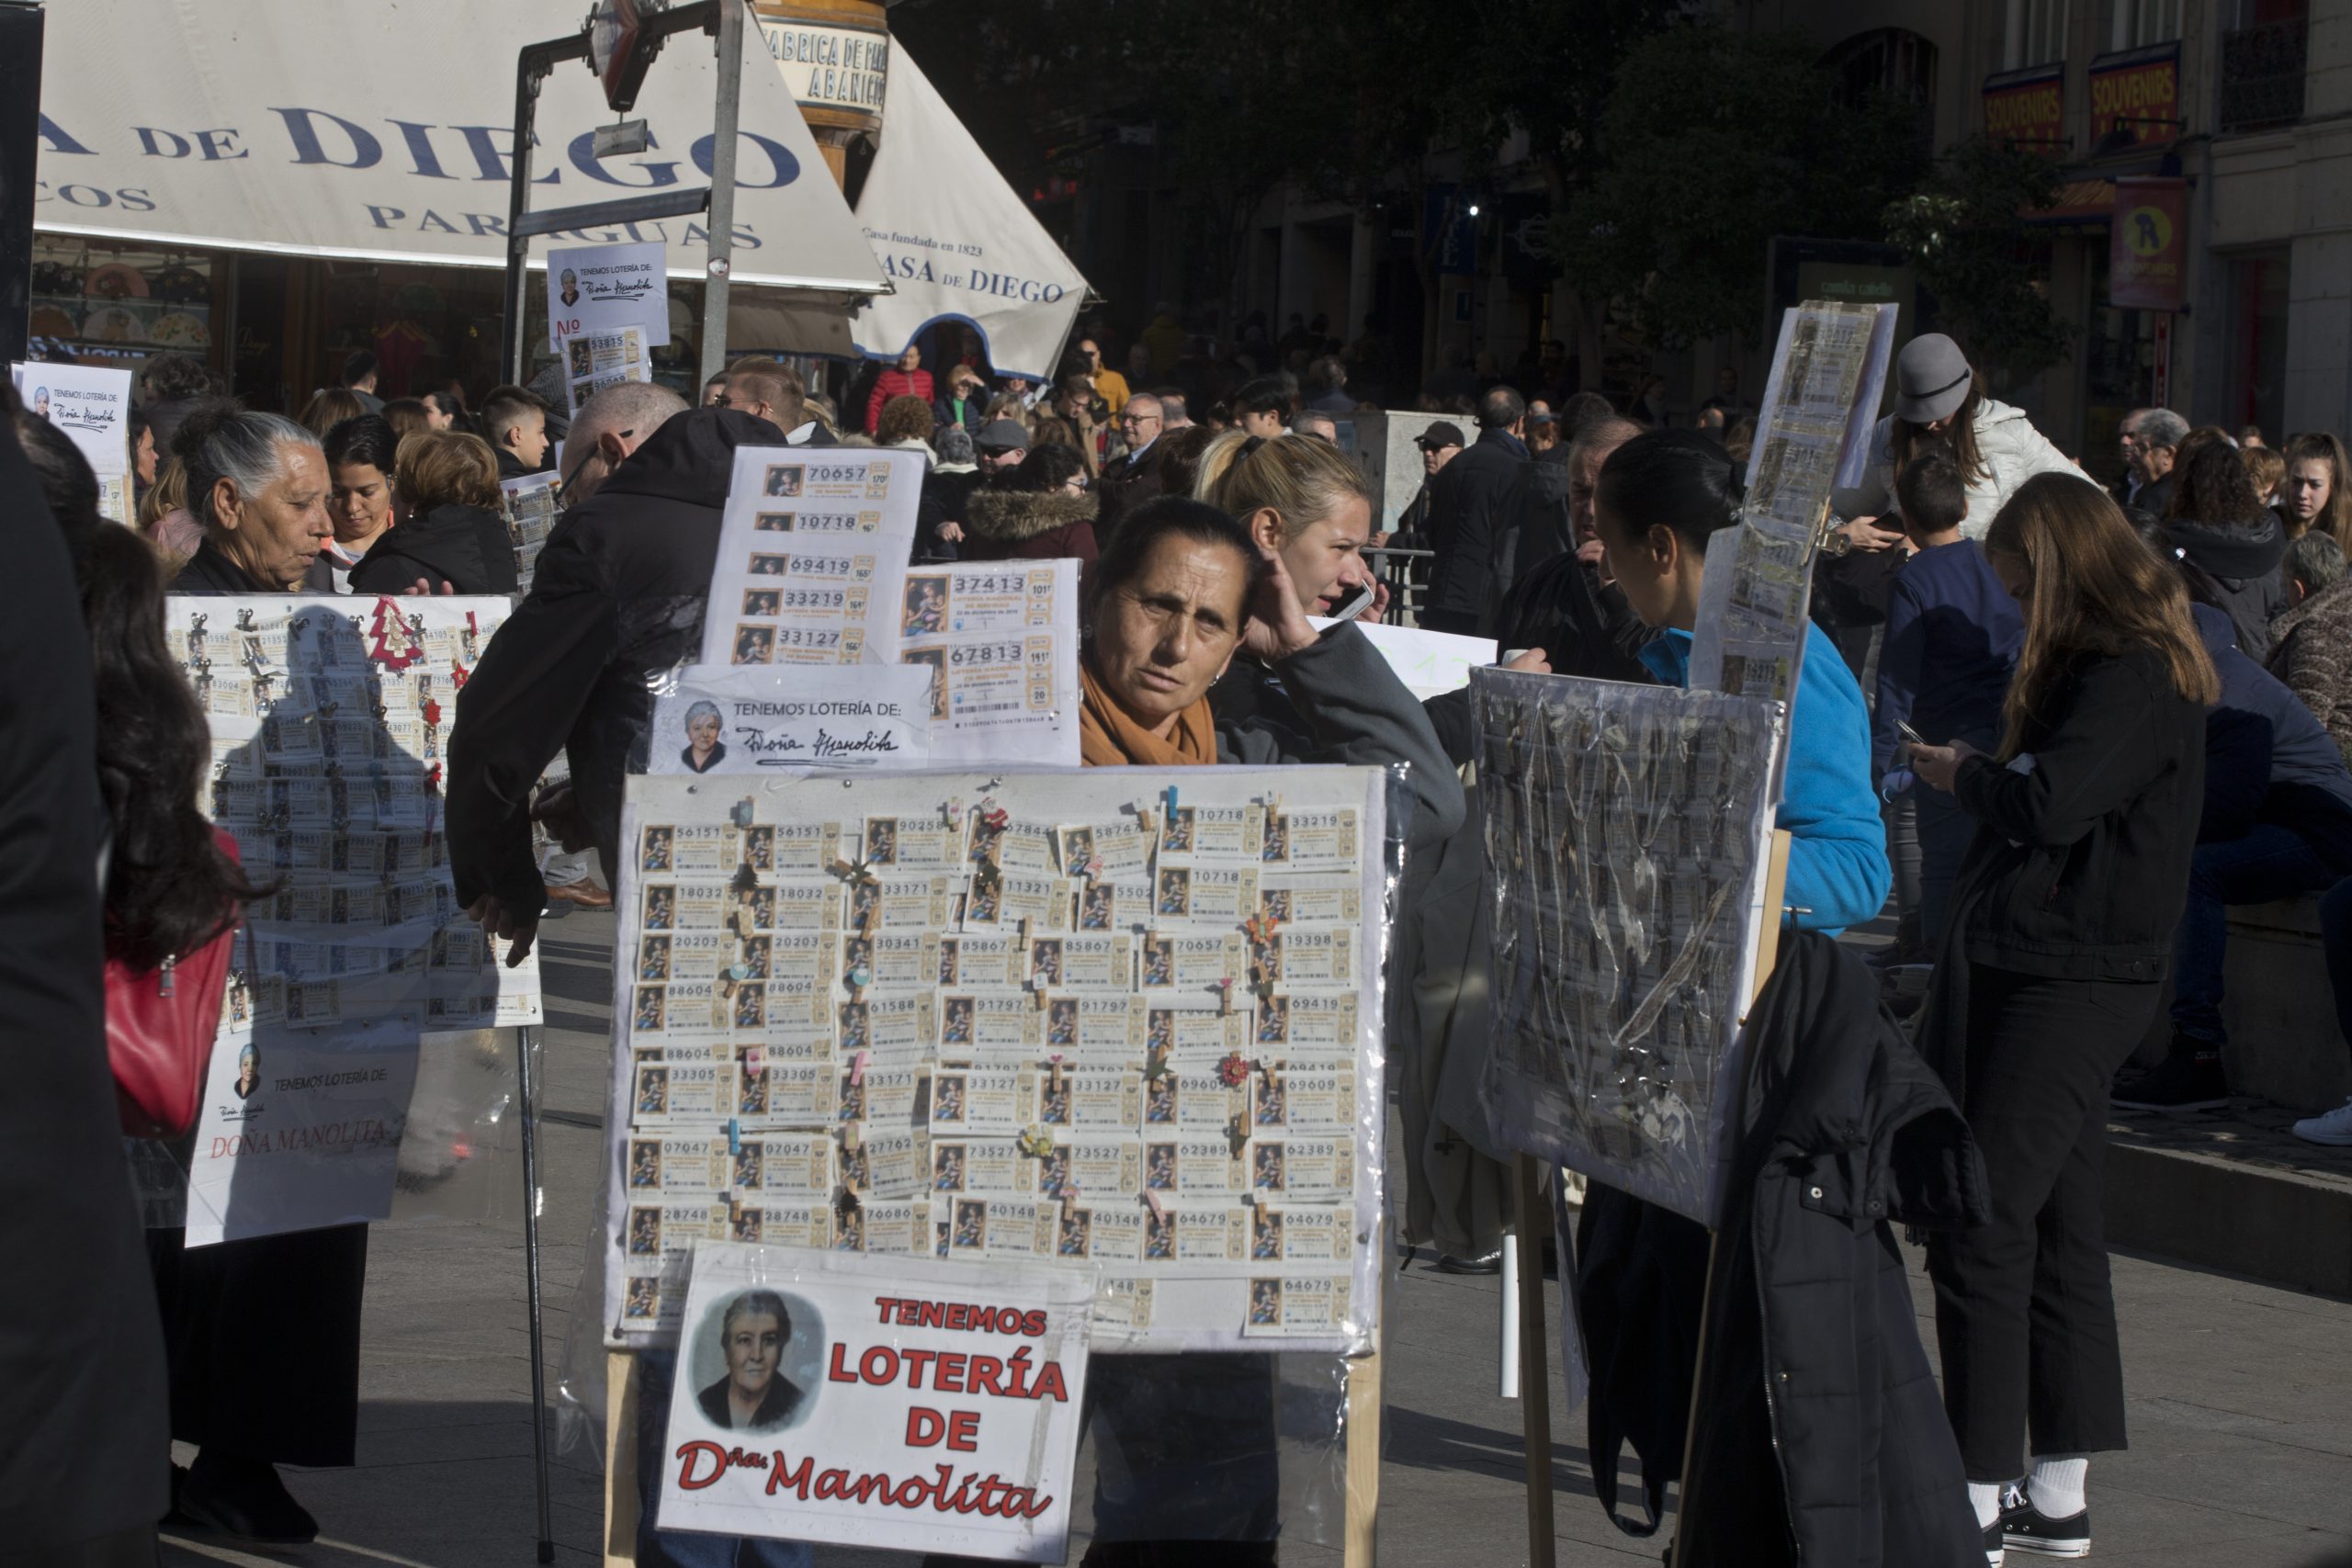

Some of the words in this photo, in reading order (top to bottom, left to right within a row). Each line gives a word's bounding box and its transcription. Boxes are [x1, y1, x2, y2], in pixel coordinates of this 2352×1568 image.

[764, 29, 839, 66] ABRICA
[844, 38, 864, 69] DE
[2092, 66, 2174, 115] SOUVENIRS
[1985, 88, 2059, 131] SOUVENIRS
[130, 127, 249, 161] DE
[267, 107, 801, 189] DIEGO
[861, 227, 888, 242] Casa
[891, 231, 939, 250] fundada
[941, 243, 954, 253] en
[957, 243, 984, 258] 1823
[580, 266, 610, 276] TENEMOS
[611, 264, 639, 274] LOTERÍA
[876, 253, 935, 284] ASA
[943, 274, 963, 288] DE
[969, 269, 1064, 304] DIEGO
[591, 336, 624, 349] 53815
[54, 389, 82, 400] TENEMOS
[83, 390, 107, 401] LOTERÍA
[809, 468, 865, 479] 70657
[800, 515, 855, 528] 10718
[791, 558, 850, 572] 69419
[955, 577, 1024, 592] 37413
[786, 592, 843, 605] 33219
[780, 629, 840, 645] 33127
[951, 645, 1022, 664] 67813
[1034, 691, 1046, 700] 20
[734, 702, 805, 716] TENEMOS
[809, 700, 872, 716] LOTERÍA
[876, 704, 901, 716] DE:
[1200, 810, 1243, 821] 10718
[899, 820, 944, 830] 90258
[1292, 816, 1338, 828] 33219
[677, 827, 720, 838] 56151
[777, 827, 820, 838] 56151
[1194, 871, 1238, 882] 10718
[680, 887, 722, 897] 18032
[780, 887, 823, 898] 18032
[884, 884, 928, 896] 33171
[1007, 880, 1050, 894] 11321
[675, 936, 718, 947] 20203
[775, 936, 819, 947] 20203
[876, 937, 920, 949] 30341
[1177, 940, 1223, 951] 70657
[1287, 934, 1331, 945] 19398
[962, 941, 1006, 952] 85867
[1066, 941, 1111, 952] 85867
[668, 985, 712, 996] 88604
[768, 982, 812, 993] 88604
[870, 999, 915, 1012] 61588
[978, 998, 1023, 1010] 91797
[1081, 1000, 1126, 1012] 91797
[1292, 998, 1339, 1010] 69419
[667, 1048, 711, 1059] 88604
[768, 1045, 812, 1056] 88604
[672, 1068, 715, 1079] 33305
[772, 1068, 816, 1079] 33305
[867, 1073, 911, 1086] 33171
[275, 1075, 322, 1093] TENEMOS
[324, 1069, 368, 1087] LOTERÍA
[969, 1077, 1015, 1089] 33127
[1075, 1080, 1121, 1091] 33127
[1288, 1079, 1335, 1090] 69609
[209, 1128, 272, 1159] DOÑA
[277, 1119, 387, 1150] MANOLITA
[664, 1143, 708, 1154] 07047
[765, 1144, 809, 1155] 07047
[869, 1138, 912, 1154] 27762
[969, 1146, 1014, 1157] 73527
[1181, 1145, 1227, 1156] 62389
[1287, 1145, 1334, 1156] 62389
[1074, 1148, 1120, 1158] 73527
[664, 1210, 707, 1220] 28748
[764, 1211, 809, 1222] 28748
[867, 1209, 911, 1219] 76686
[989, 1204, 1035, 1217] 40148
[1093, 1213, 1140, 1226] 40148
[1180, 1213, 1227, 1224] 64679
[1286, 1213, 1333, 1225] 64679
[1285, 1279, 1331, 1291] 64679
[875, 1297, 1047, 1337] TENEMOS
[828, 1343, 1069, 1403] LOTERÍA
[904, 1405, 981, 1452] DE
